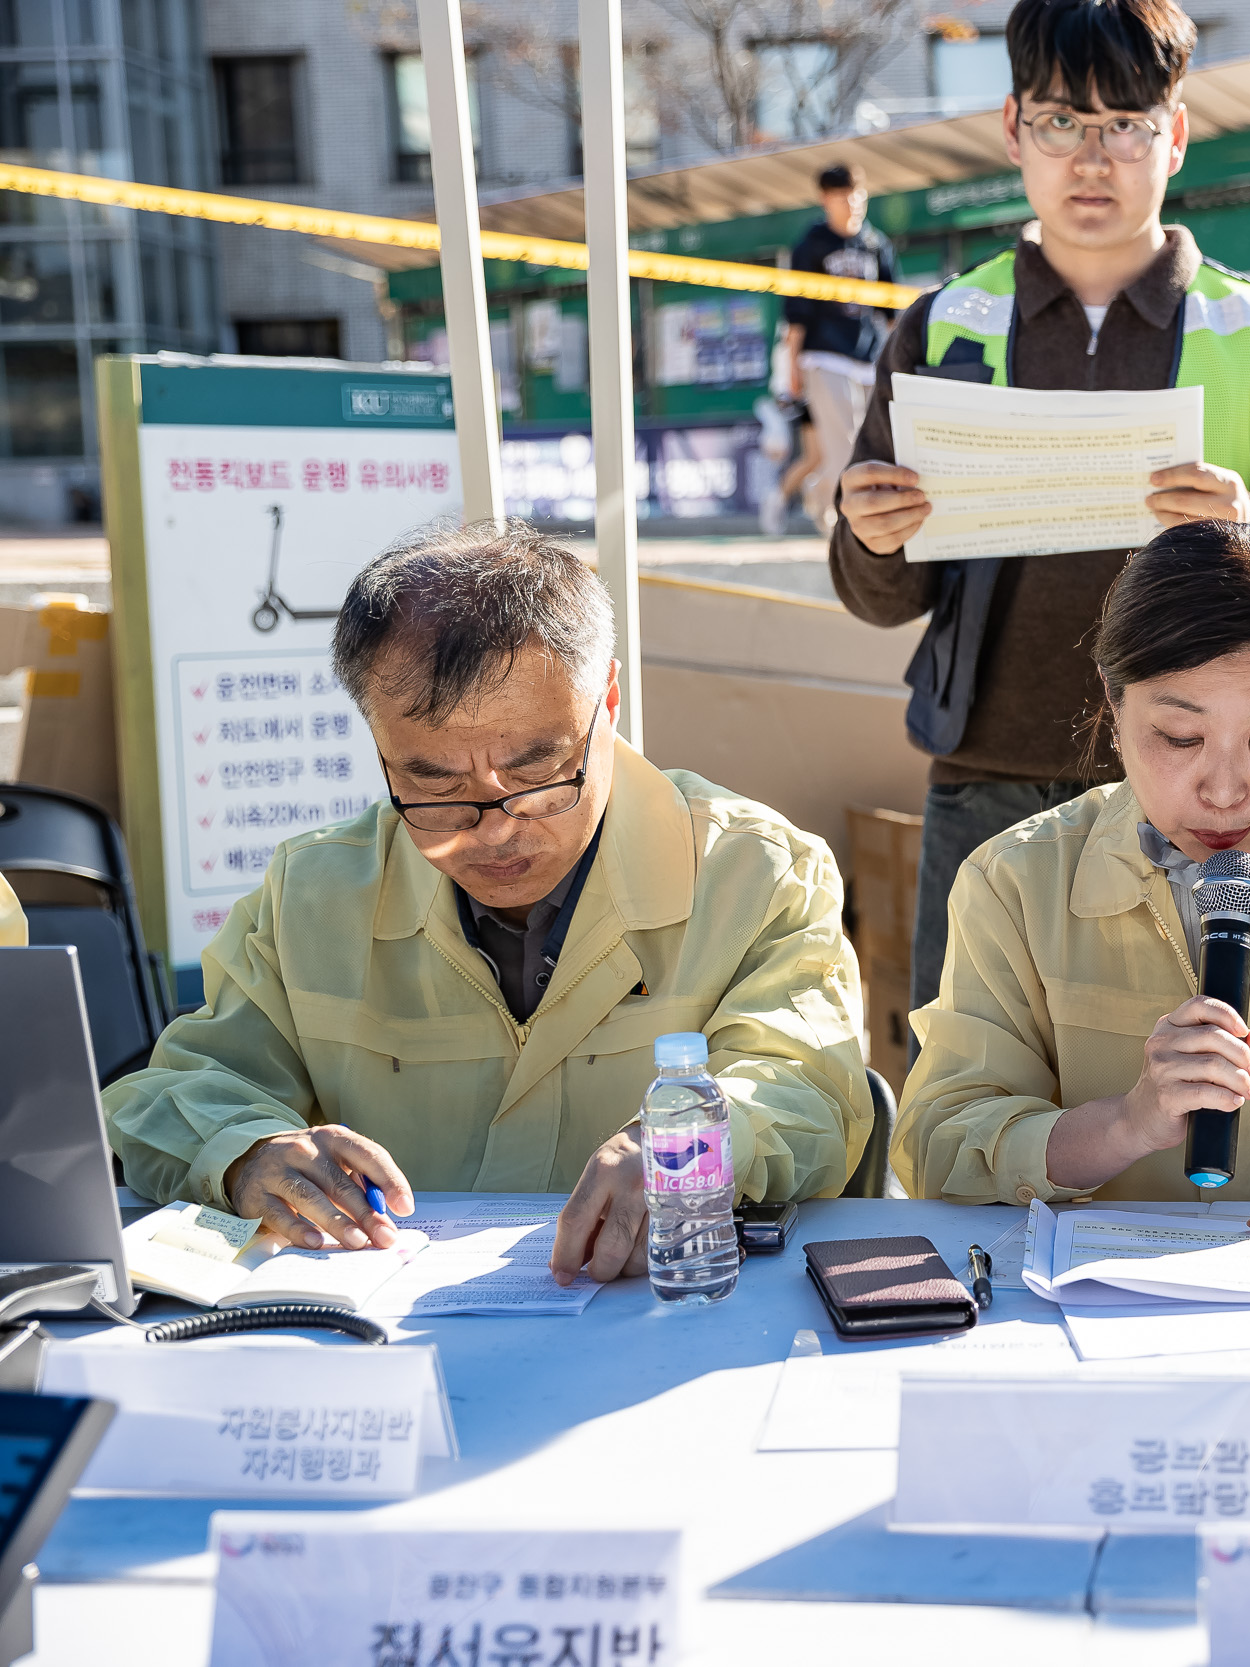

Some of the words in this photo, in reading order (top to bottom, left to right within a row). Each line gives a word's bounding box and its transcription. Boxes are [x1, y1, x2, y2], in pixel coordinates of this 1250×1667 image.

[168, 457, 292, 492] 전동킥보드
[302, 457, 351, 492] 운행
[357, 458, 450, 493] 유의사항
[216, 671, 300, 701] 운전면허
[310, 711, 351, 742] 운행
[312, 753, 352, 784] 착용
[216, 1405, 414, 1442] 자원봉사지원반
[240, 1445, 382, 1482] 자치행정과
